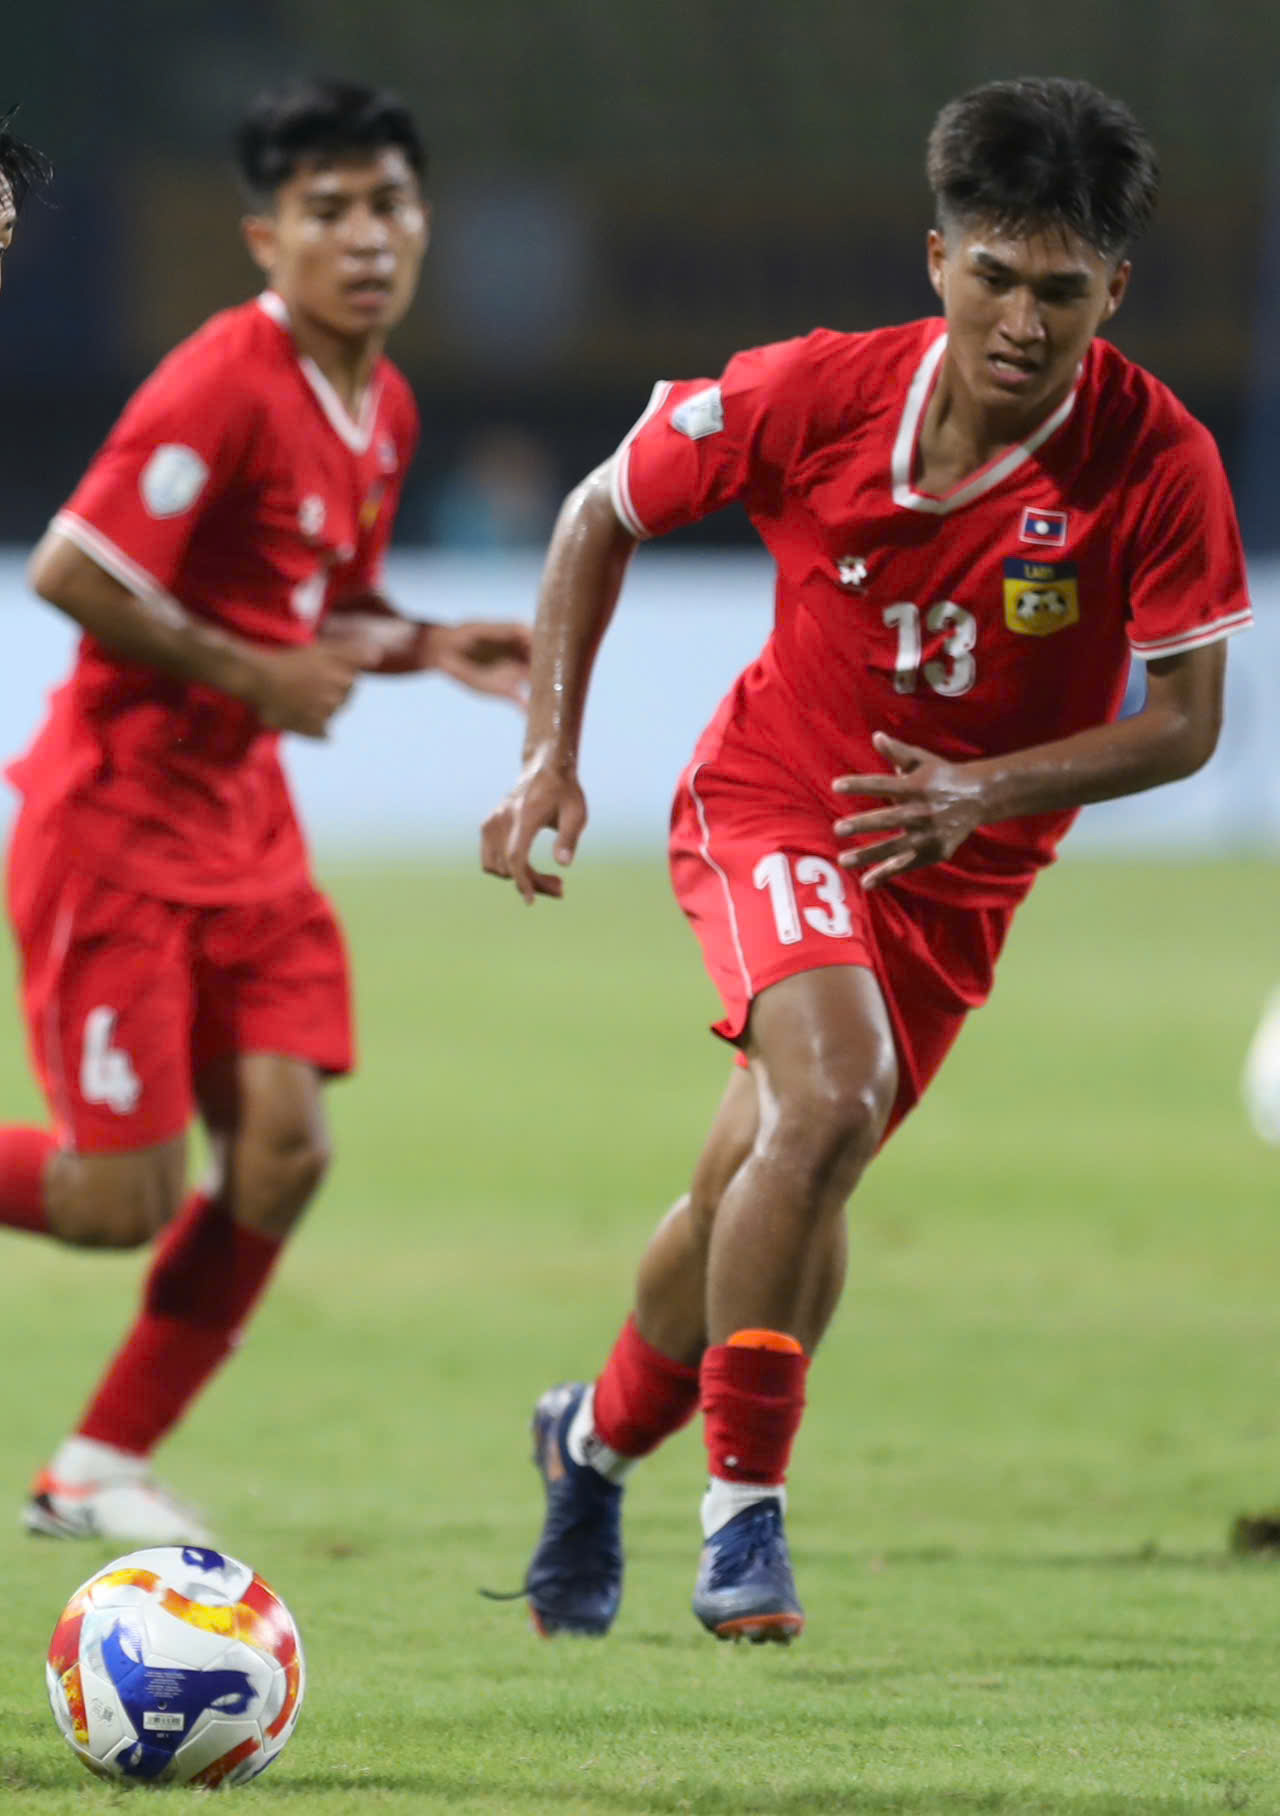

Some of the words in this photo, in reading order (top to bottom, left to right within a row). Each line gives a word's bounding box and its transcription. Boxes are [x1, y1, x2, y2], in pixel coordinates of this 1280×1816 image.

[882, 600, 977, 697] 13
[752, 851, 853, 945] 13
[79, 1004, 143, 1116] 4
